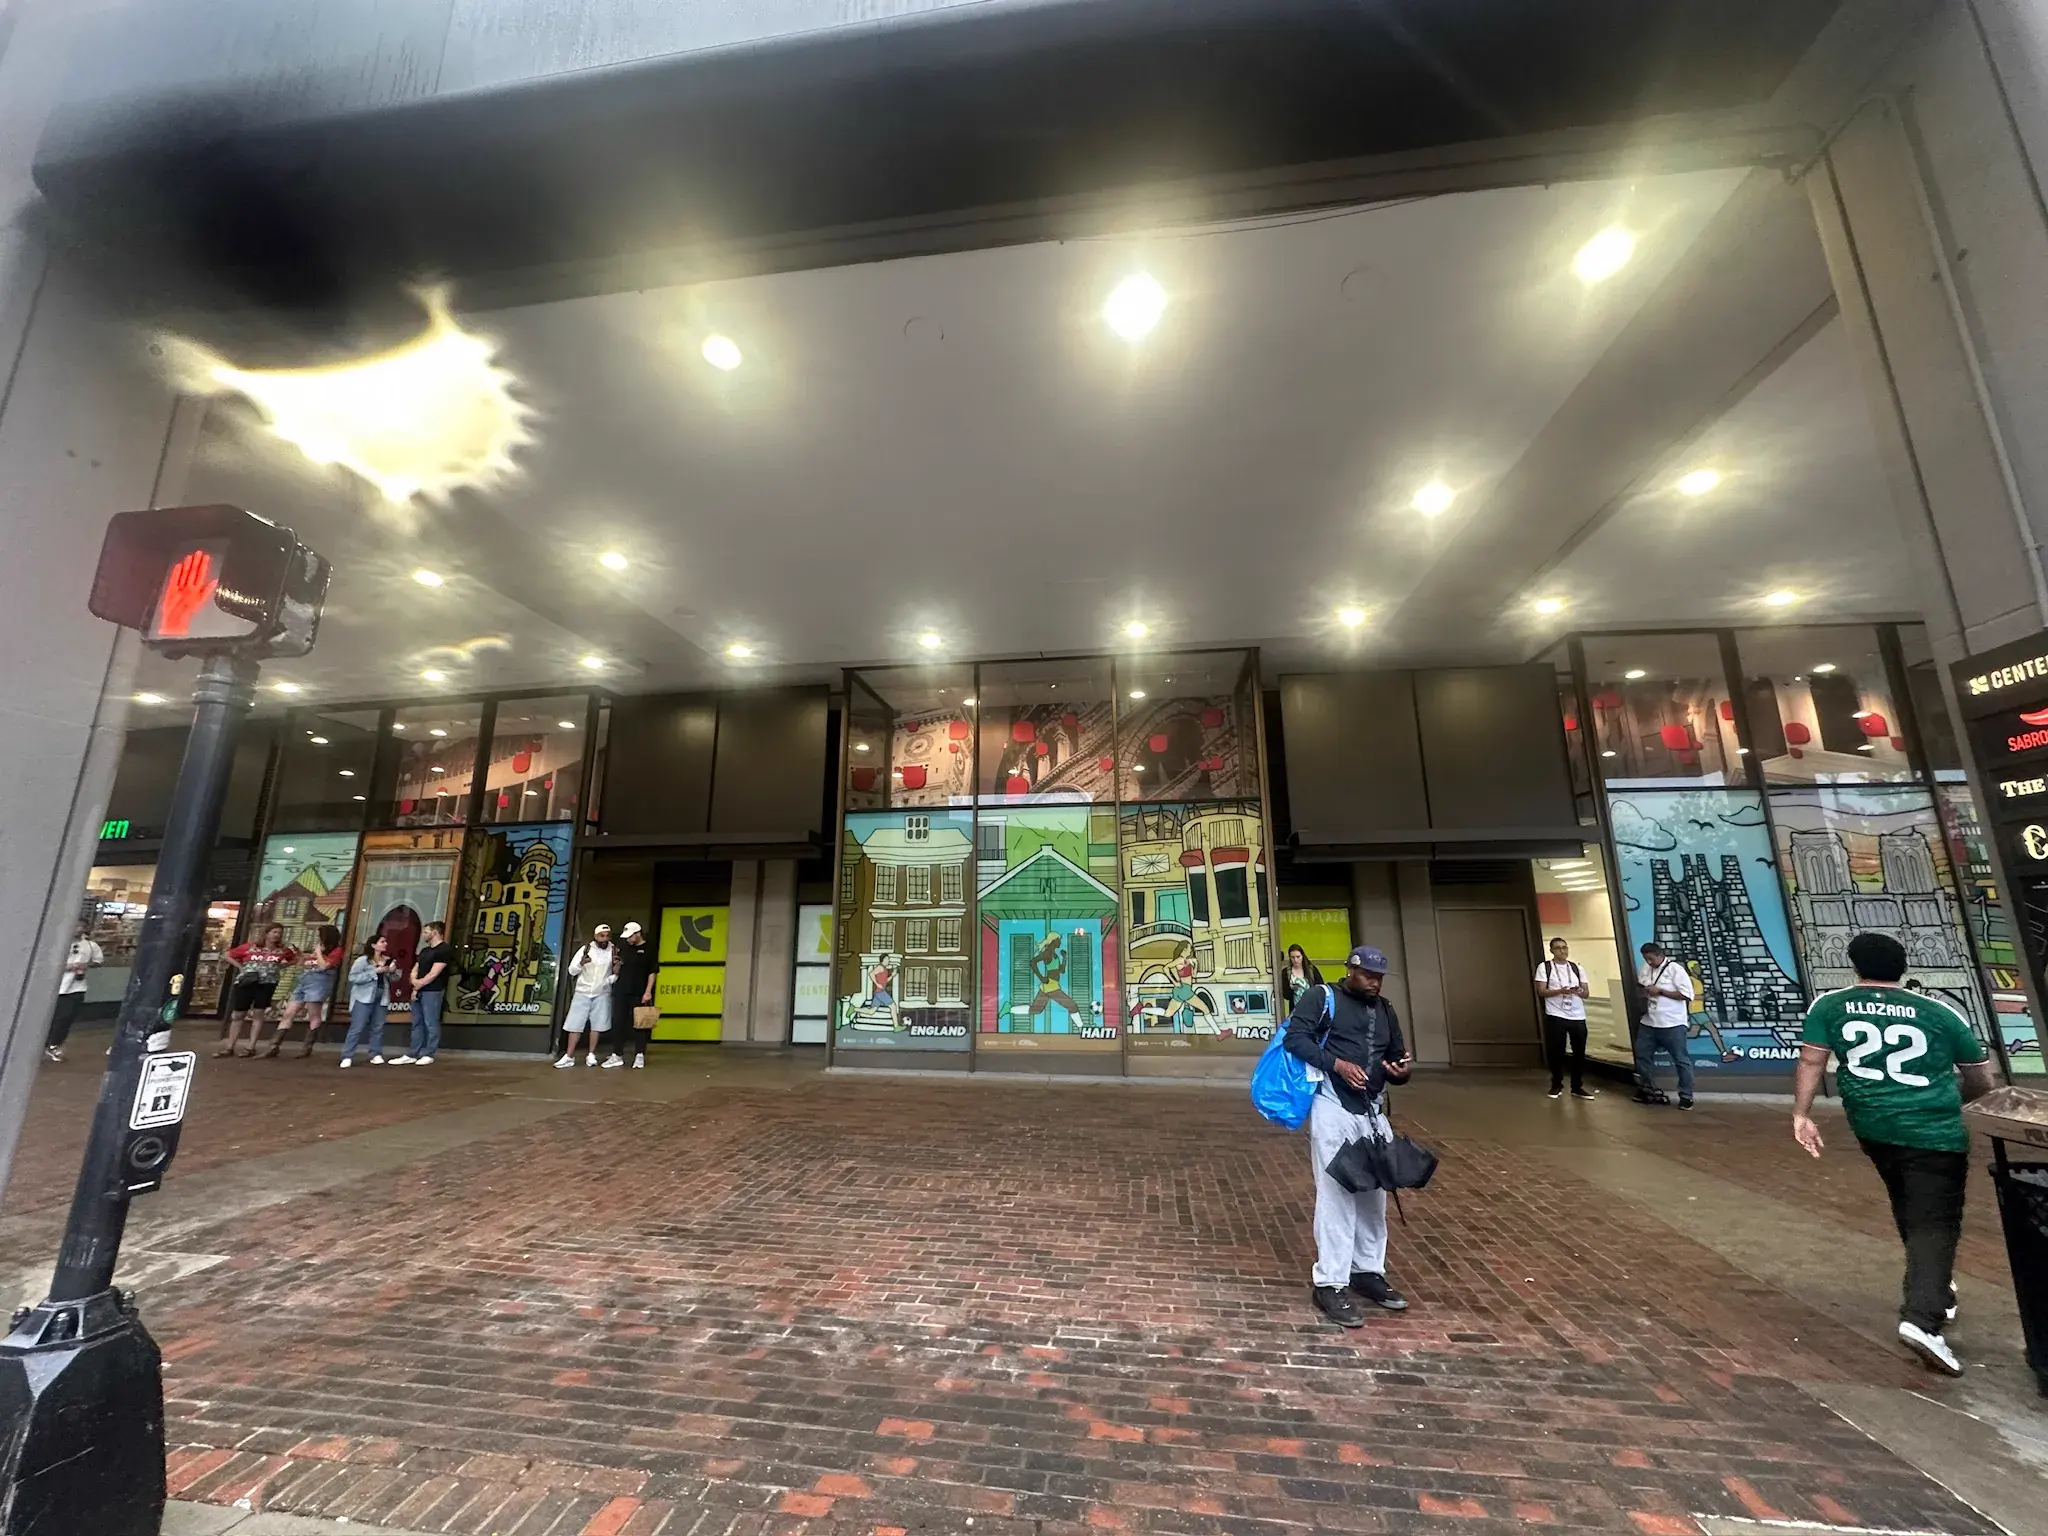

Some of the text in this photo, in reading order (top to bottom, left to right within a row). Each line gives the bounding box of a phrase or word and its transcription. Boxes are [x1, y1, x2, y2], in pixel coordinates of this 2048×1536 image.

[1991, 655, 2048, 689] CENTE
[2008, 730, 2048, 751] SABRO
[2000, 778, 2046, 797] THE
[659, 984, 722, 995] CENTER PLAZA
[800, 984, 829, 996] CENTE
[493, 1002, 540, 1012] SCOTLAND
[1845, 1001, 1917, 1019] H.LOZANO
[910, 1025, 967, 1036] ENGLAND
[1081, 1028, 1116, 1039] HAITI
[1236, 1027, 1270, 1040] IRAQ
[1749, 1047, 1800, 1059] GHANA
[1841, 1020, 1930, 1087] 22
